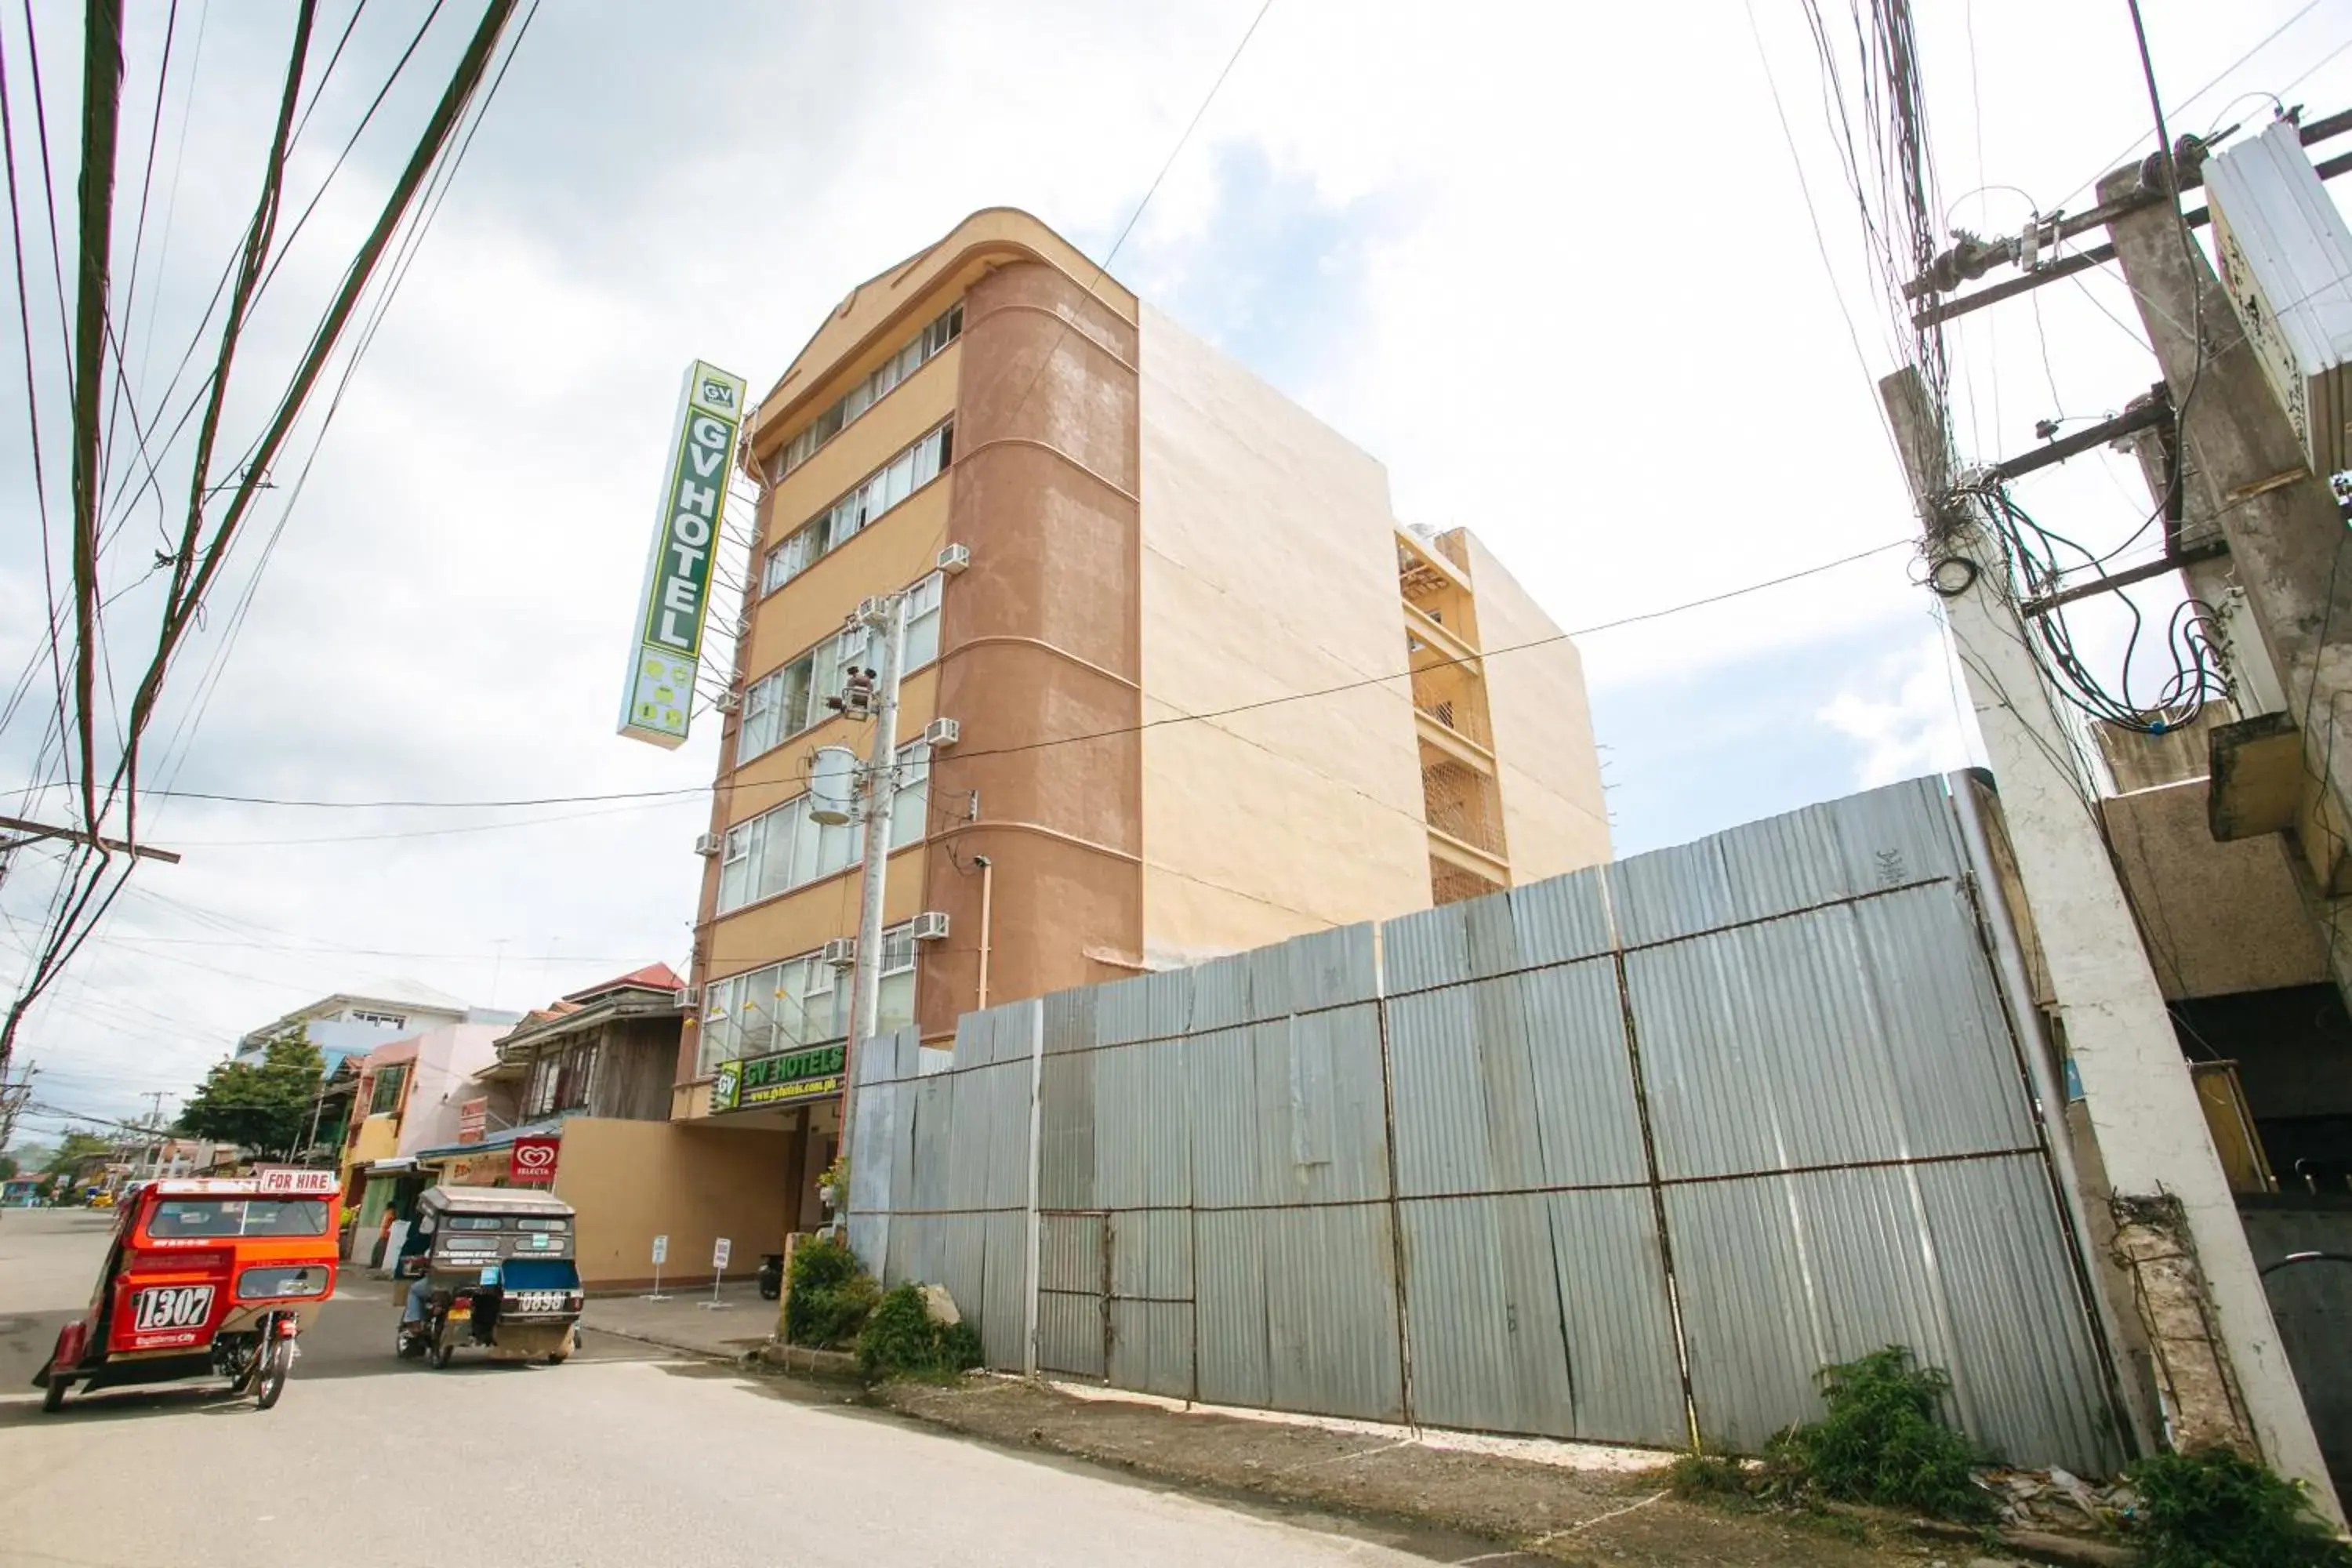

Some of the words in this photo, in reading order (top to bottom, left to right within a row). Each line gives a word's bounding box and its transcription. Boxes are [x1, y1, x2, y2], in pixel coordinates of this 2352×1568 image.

[705, 384, 731, 400] GV
[690, 417, 728, 477] GV
[660, 478, 716, 648] HOTEL
[718, 1074, 736, 1094] GV
[748, 1061, 768, 1086] GV
[776, 1047, 843, 1080] HOTELS
[268, 1174, 292, 1189] FOR
[297, 1174, 328, 1189] HIRE
[140, 1288, 211, 1327] 1307
